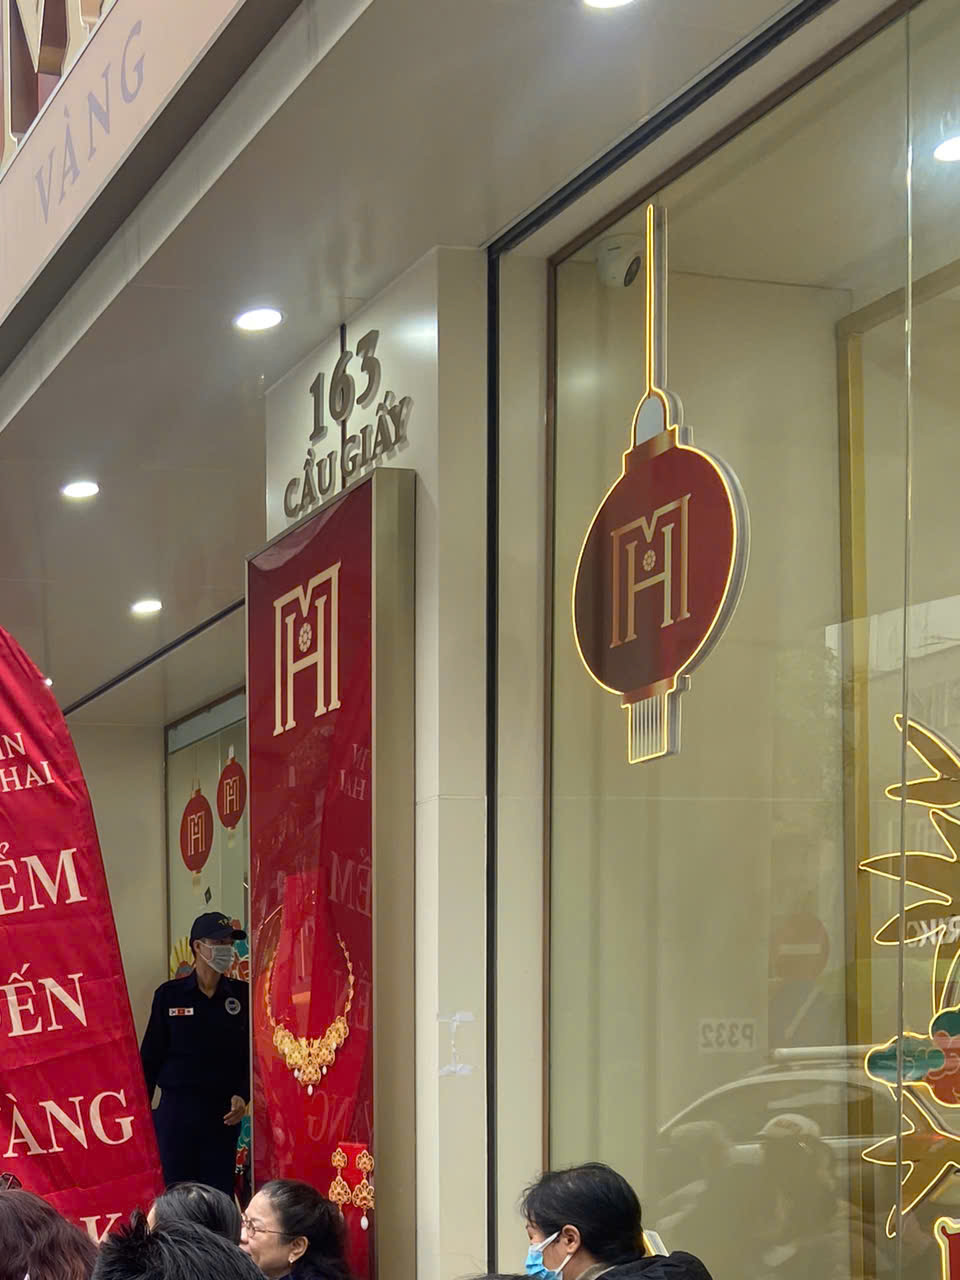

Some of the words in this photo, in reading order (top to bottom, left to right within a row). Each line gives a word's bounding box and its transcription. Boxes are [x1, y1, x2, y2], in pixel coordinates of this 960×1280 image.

[33, 19, 146, 225] VÀNG
[308, 329, 382, 443] 163
[283, 448, 339, 519] CẦU
[340, 390, 412, 476] GIẤY
